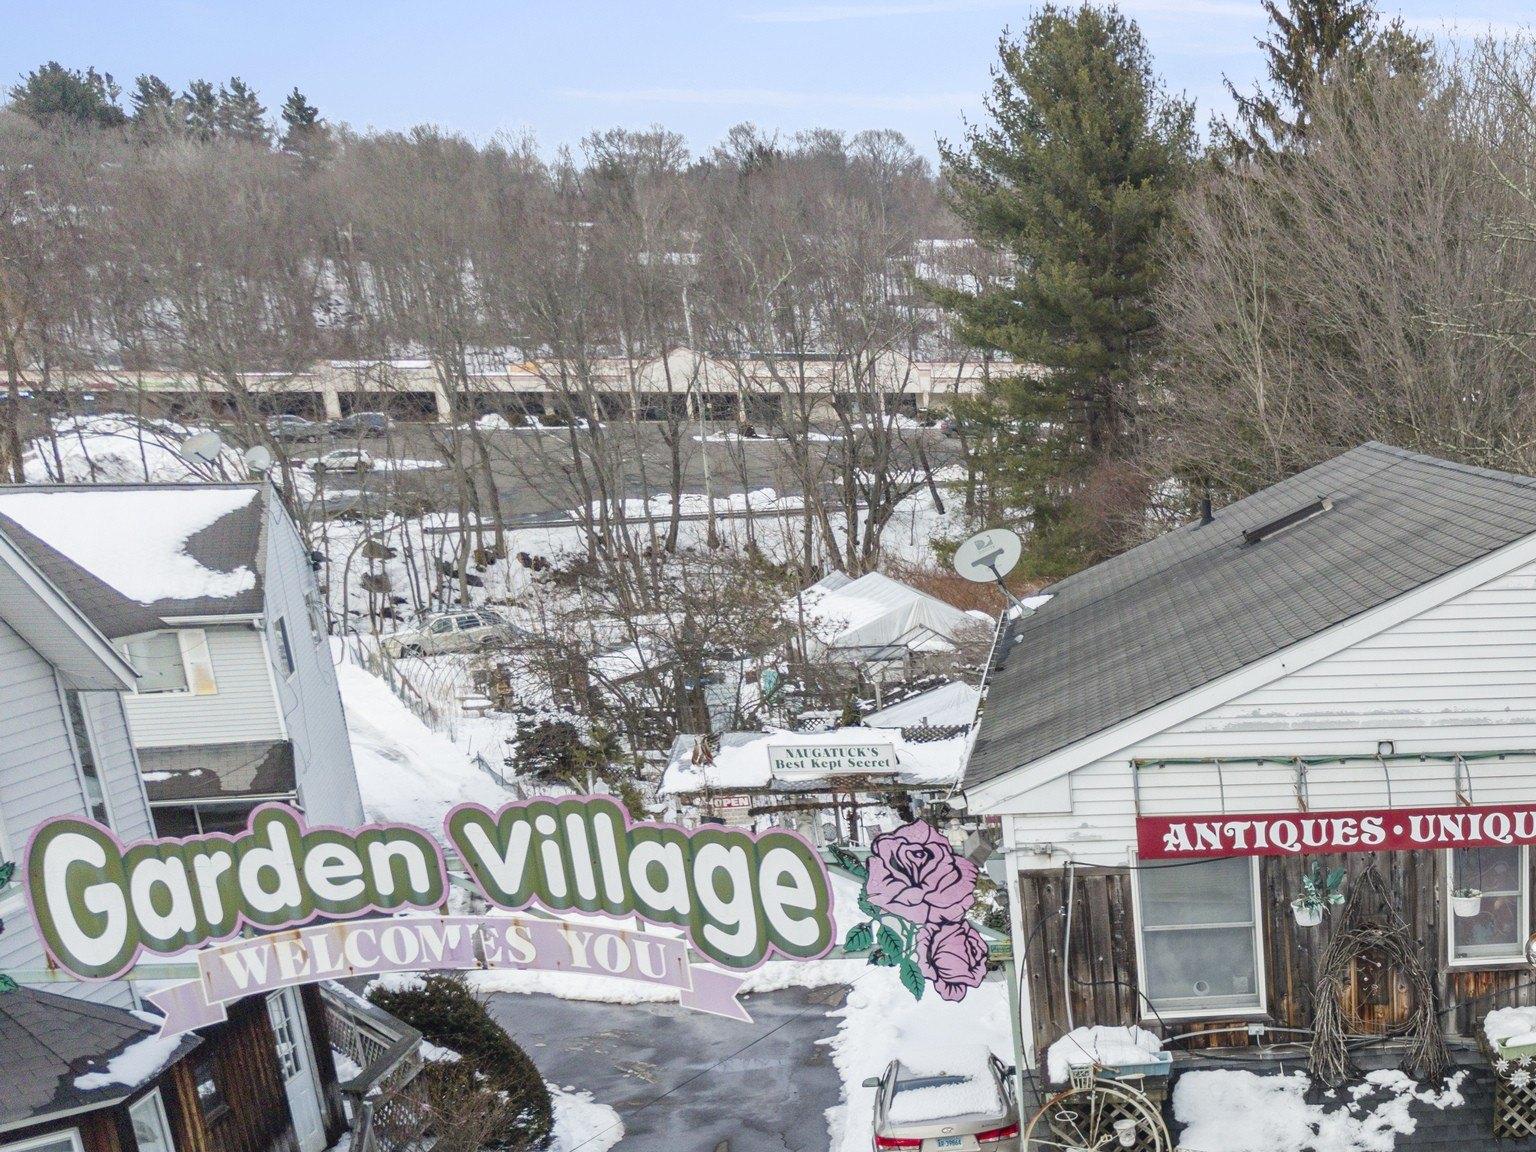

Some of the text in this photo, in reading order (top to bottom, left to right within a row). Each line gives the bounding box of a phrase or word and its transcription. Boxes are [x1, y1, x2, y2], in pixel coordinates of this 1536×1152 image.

[775, 757, 891, 770] Best Kept Secret
[785, 746, 879, 759] NAUGATUCK'S
[714, 797, 749, 807] OPEN
[1163, 816, 1387, 852] ANTIQUES
[43, 811, 821, 967] Garden Village
[219, 922, 668, 990] WELCOMES YOU
